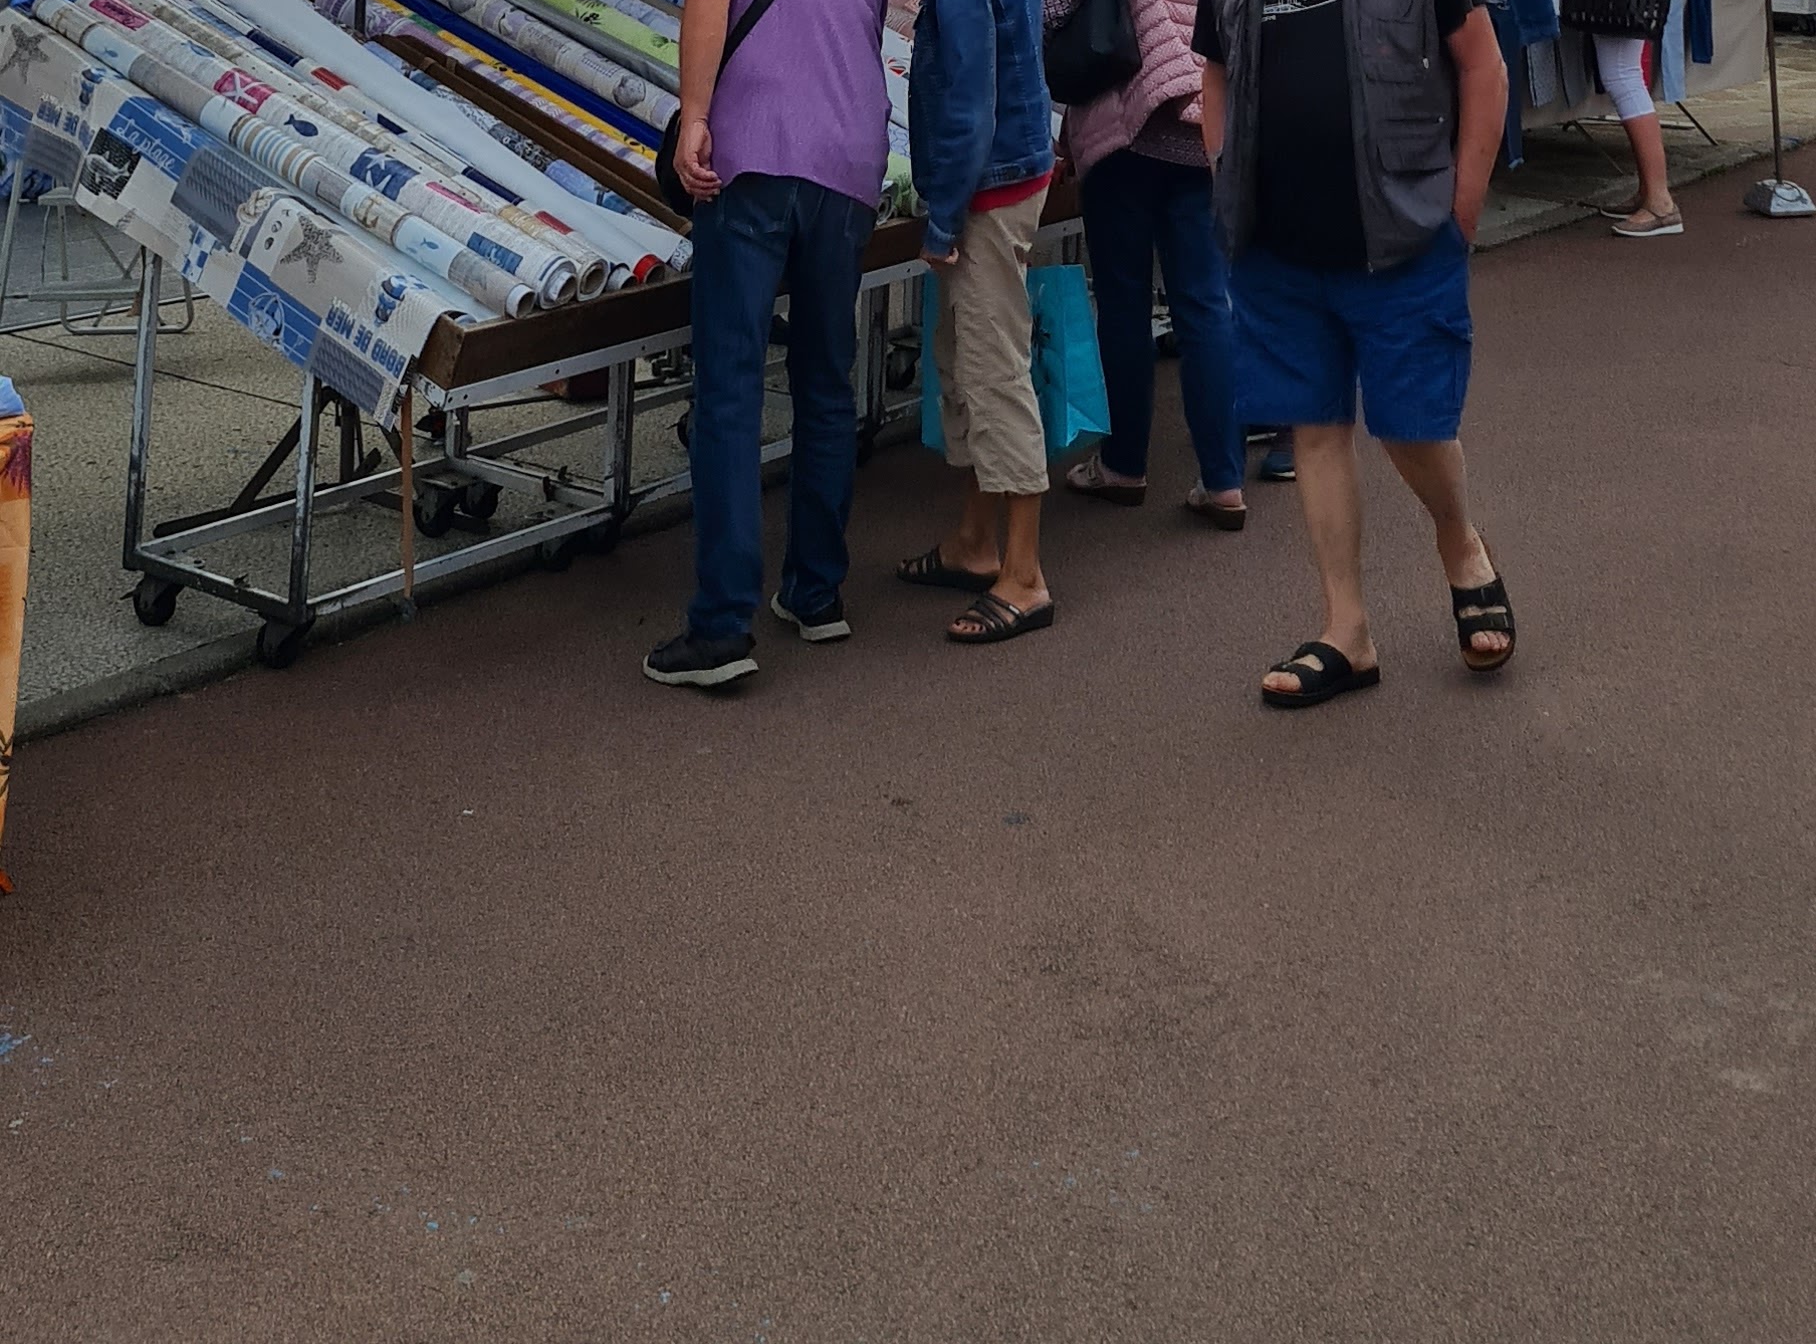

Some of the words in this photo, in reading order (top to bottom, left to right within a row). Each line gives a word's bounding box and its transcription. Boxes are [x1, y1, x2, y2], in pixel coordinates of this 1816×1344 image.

[325, 305, 356, 339] MER
[353, 324, 373, 354] DE
[371, 338, 407, 379] BORD
